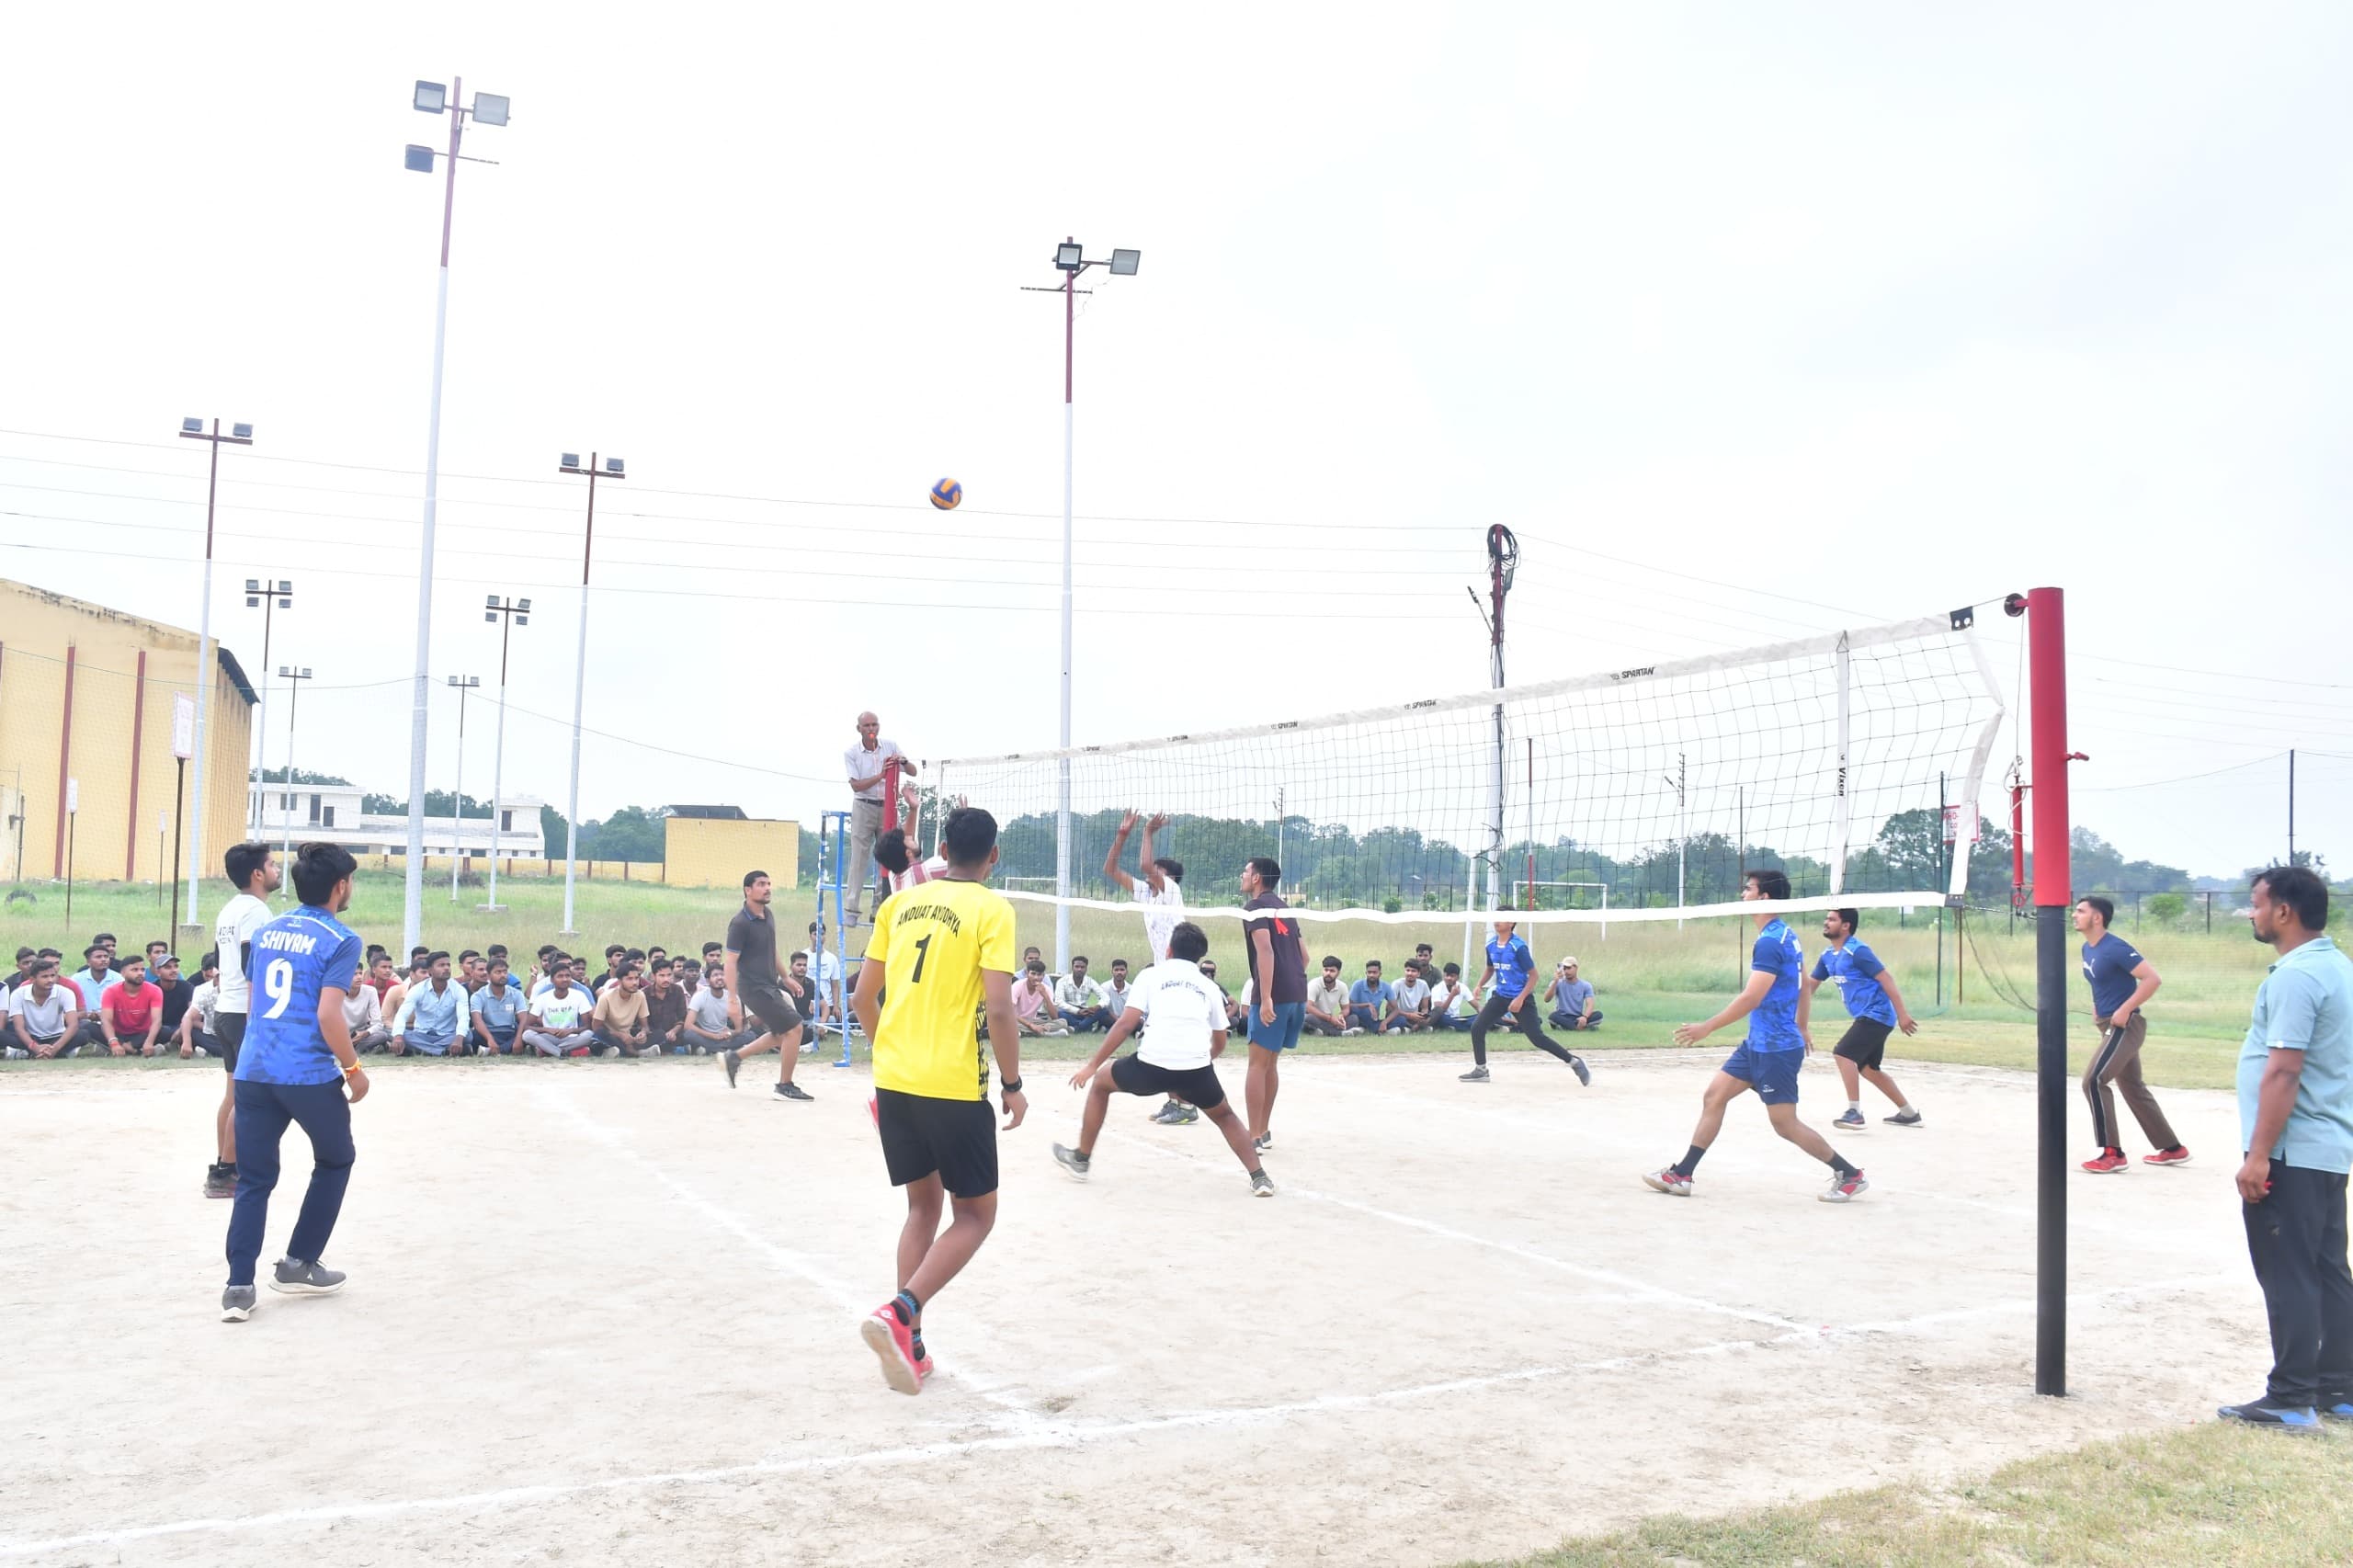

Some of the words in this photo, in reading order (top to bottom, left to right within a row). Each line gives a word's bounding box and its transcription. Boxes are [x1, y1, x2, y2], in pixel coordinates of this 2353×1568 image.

[1621, 666, 1655, 678] SPARTAN
[897, 905, 932, 927] ANDUAT
[259, 931, 316, 955] SHIVAM
[912, 933, 932, 983] 1
[262, 958, 293, 1019] 9
